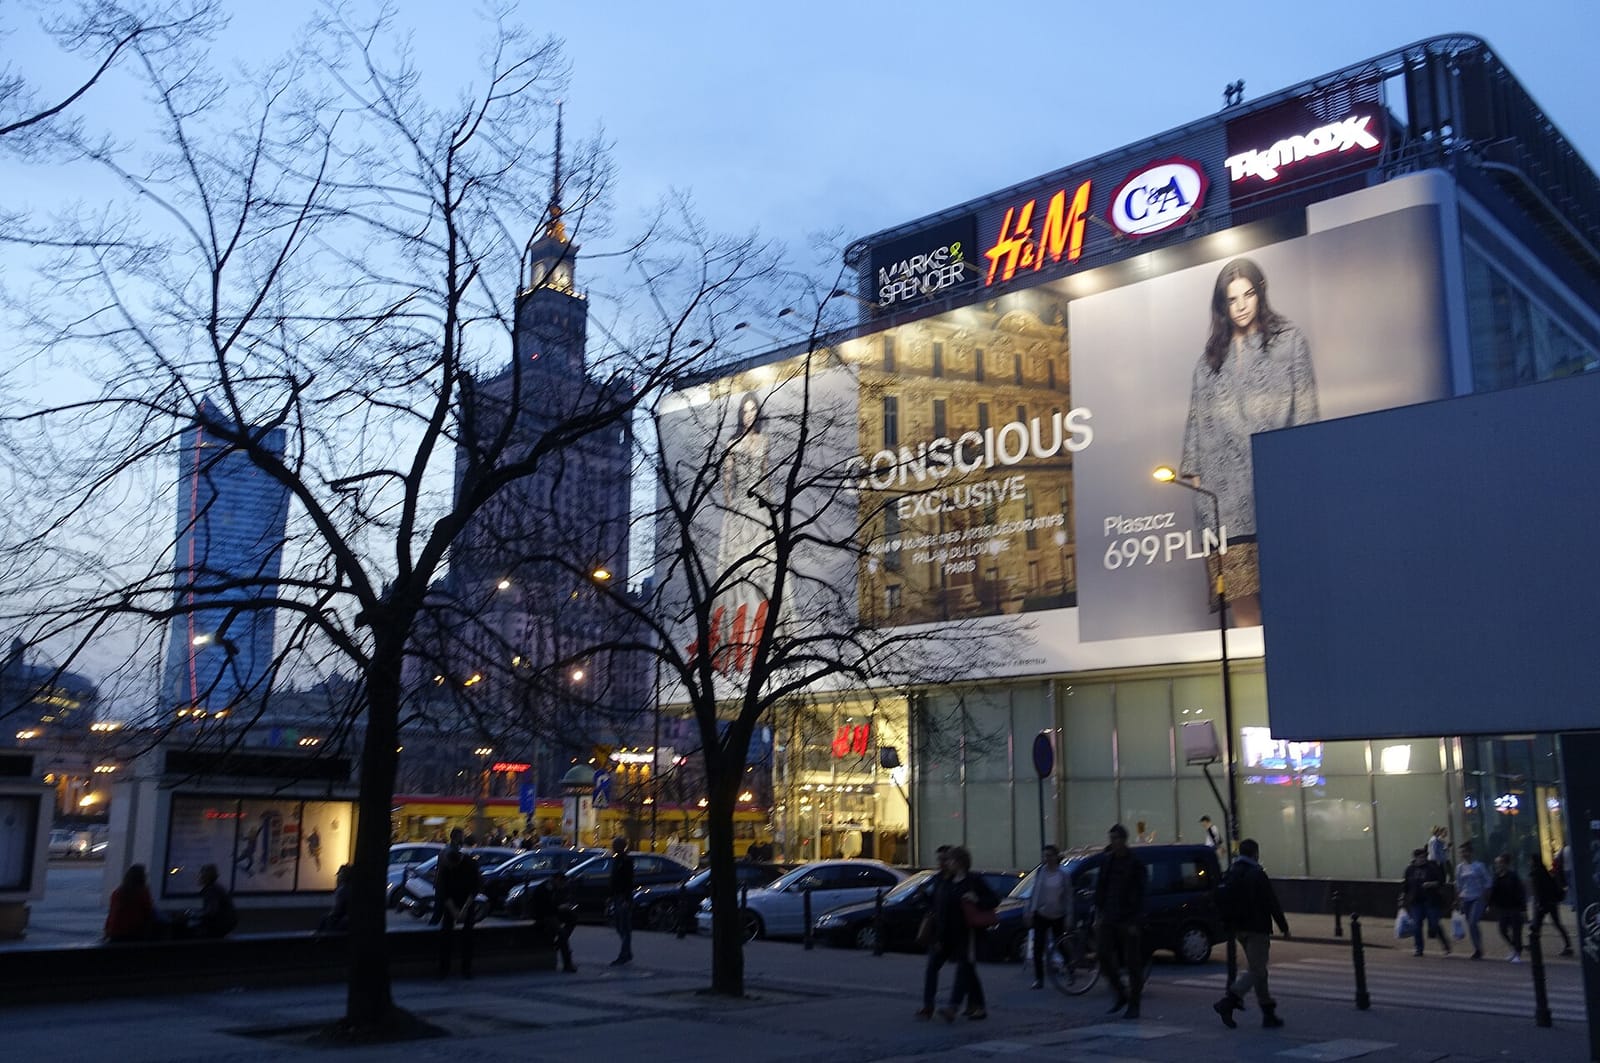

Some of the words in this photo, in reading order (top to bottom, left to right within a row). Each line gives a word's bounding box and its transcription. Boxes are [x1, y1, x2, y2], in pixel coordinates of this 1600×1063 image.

[1124, 175, 1190, 222] C&A
[983, 179, 1092, 287] H&M
[879, 262, 965, 307] SPENCER
[843, 406, 1095, 496] CONSCIOUS
[896, 474, 1027, 521] EXCLUSIVE
[945, 559, 977, 576] PARIS
[1104, 535, 1161, 570] 699
[1164, 525, 1228, 562] PLN
